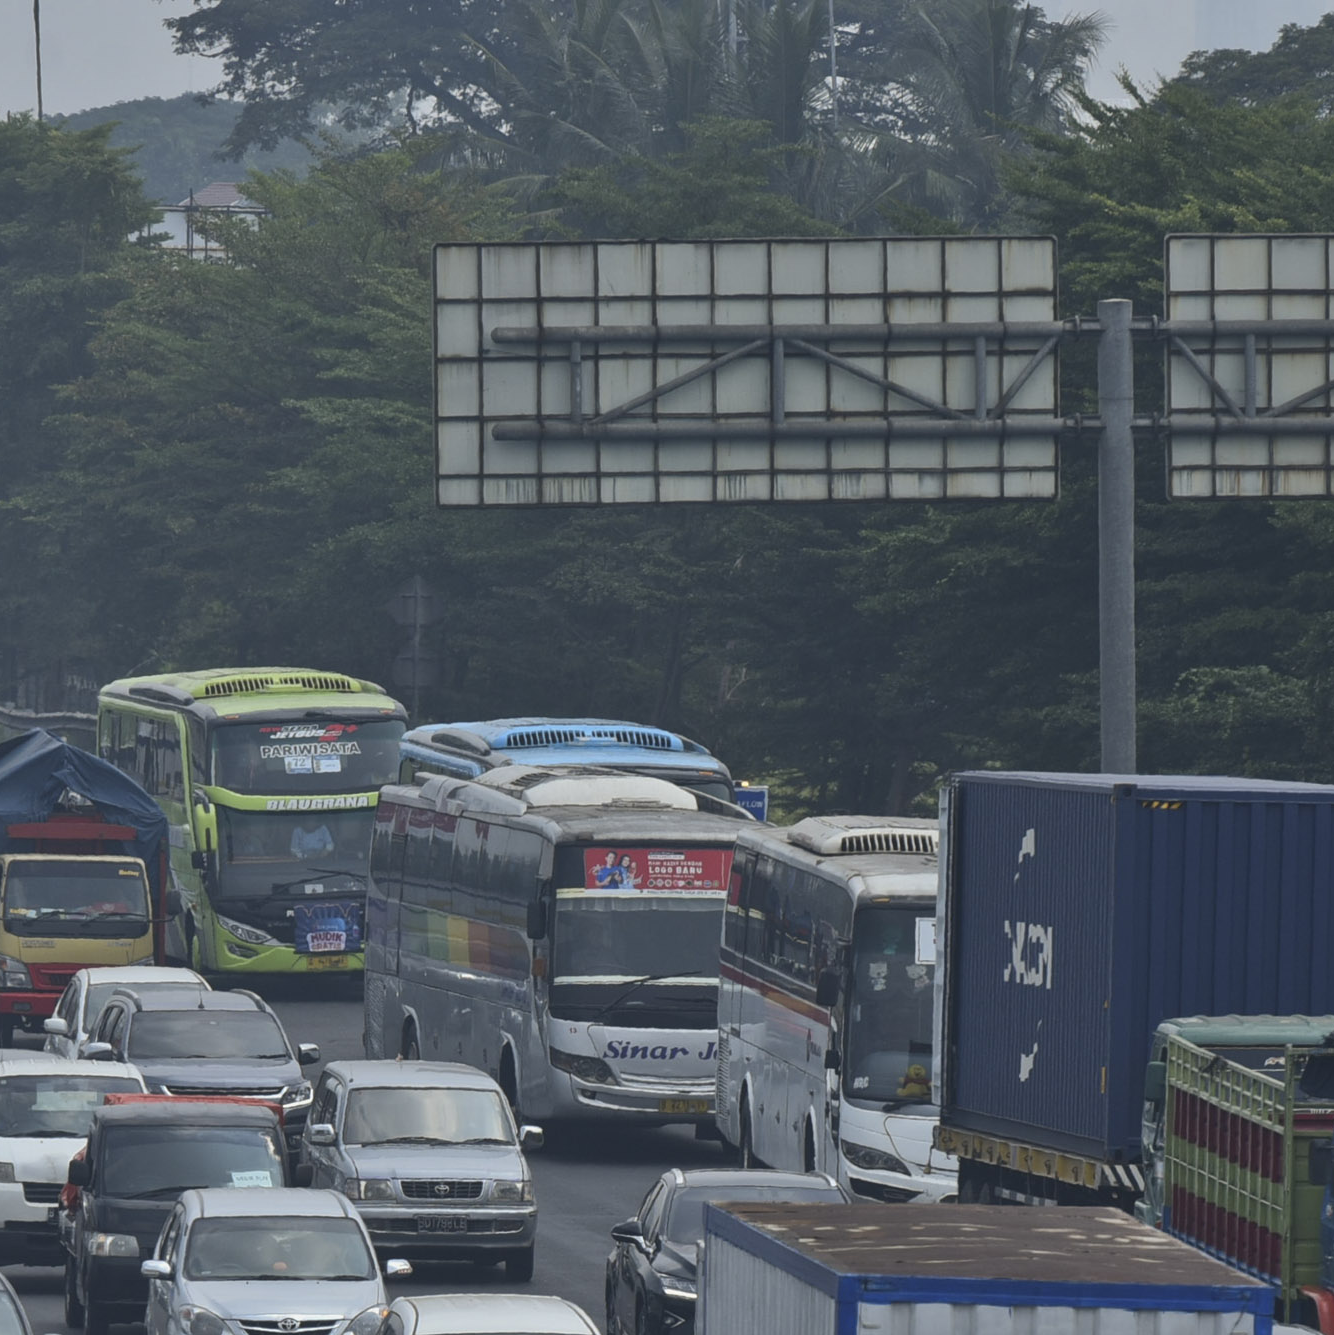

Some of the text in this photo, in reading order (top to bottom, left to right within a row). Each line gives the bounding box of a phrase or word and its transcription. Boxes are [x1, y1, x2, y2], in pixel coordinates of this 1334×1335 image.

[260, 741, 362, 758] PARIWISATA
[293, 758, 307, 768] 72
[266, 796, 369, 811] BLAUGRANA
[648, 866, 703, 875] LOGO BARU
[310, 932, 343, 942] MUDIK
[602, 1040, 690, 1060] Sinar
